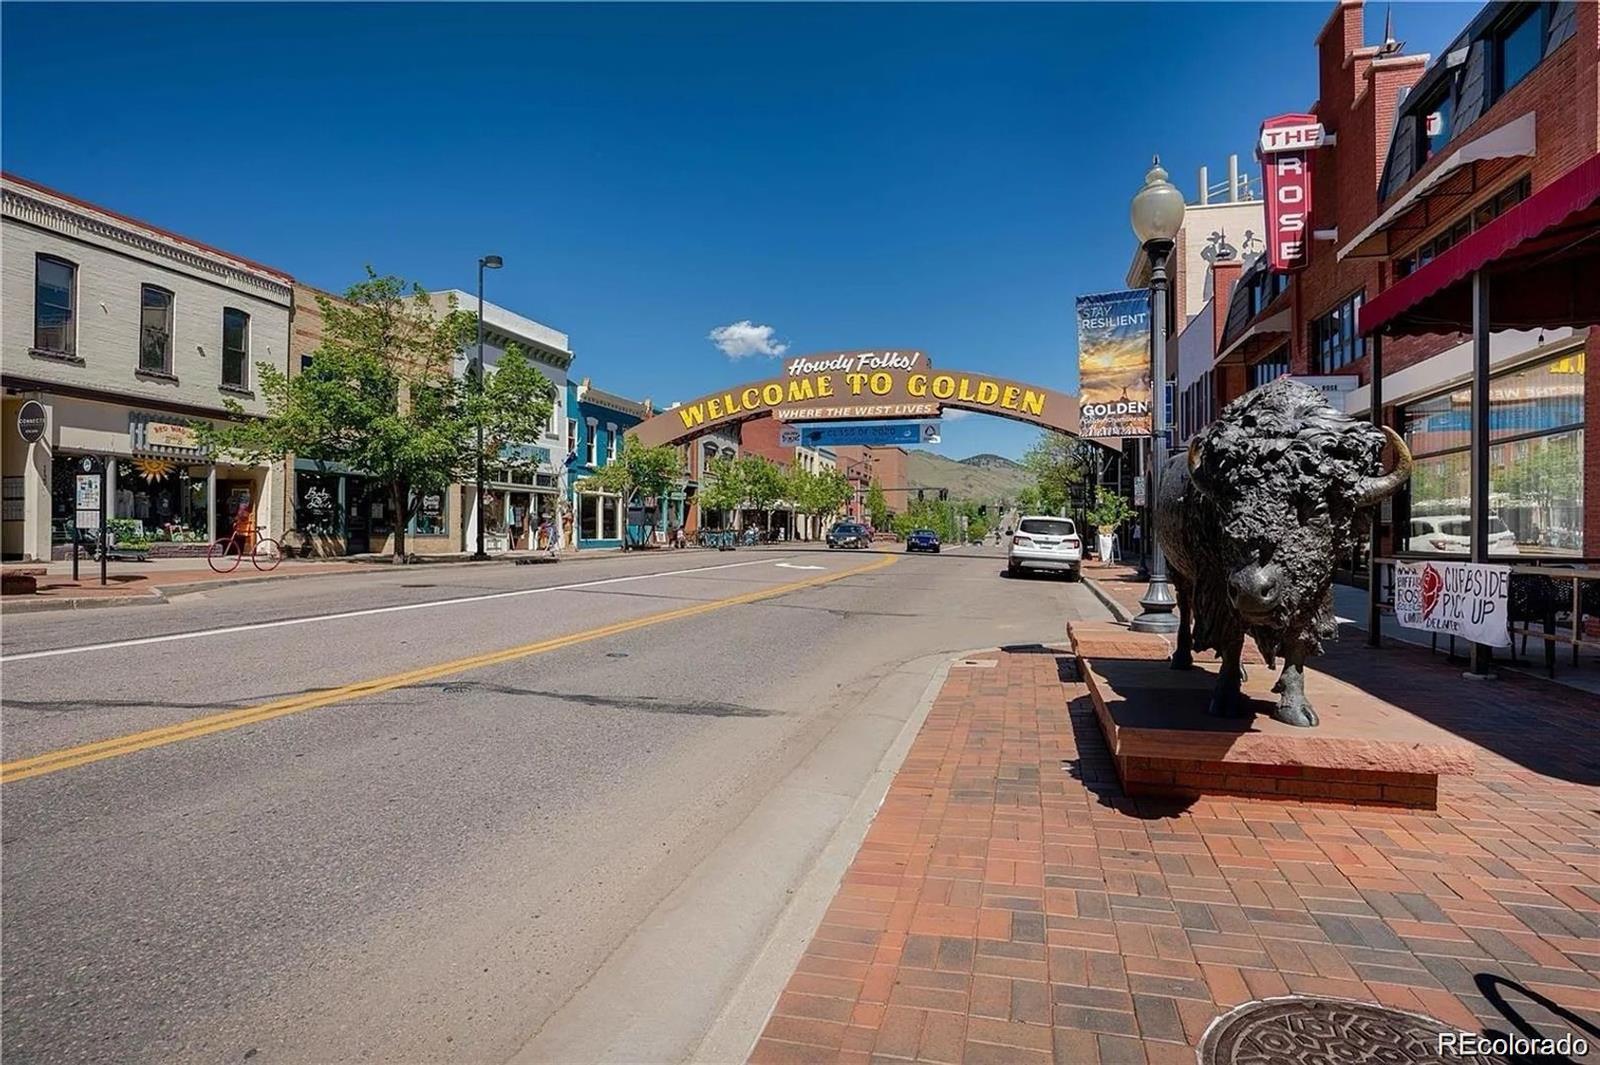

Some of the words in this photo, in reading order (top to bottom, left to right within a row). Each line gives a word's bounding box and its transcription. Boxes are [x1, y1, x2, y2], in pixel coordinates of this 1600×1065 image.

[1267, 129, 1320, 146] THE
[1278, 158, 1304, 260] ROSE
[1083, 305, 1112, 318] STAY
[1082, 313, 1147, 329] RESILIENT
[788, 354, 856, 377] Howdy
[856, 352, 921, 372] Folks!
[678, 375, 834, 430] WELCOME
[846, 372, 893, 396] TO
[907, 375, 1046, 418] GOLDEN
[1082, 402, 1148, 416] GOLDEN
[778, 408, 823, 419] WHERE
[827, 407, 853, 417] THE
[855, 405, 892, 416] WEST
[895, 404, 932, 415] LIVES
[1471, 599, 1496, 625] UP
